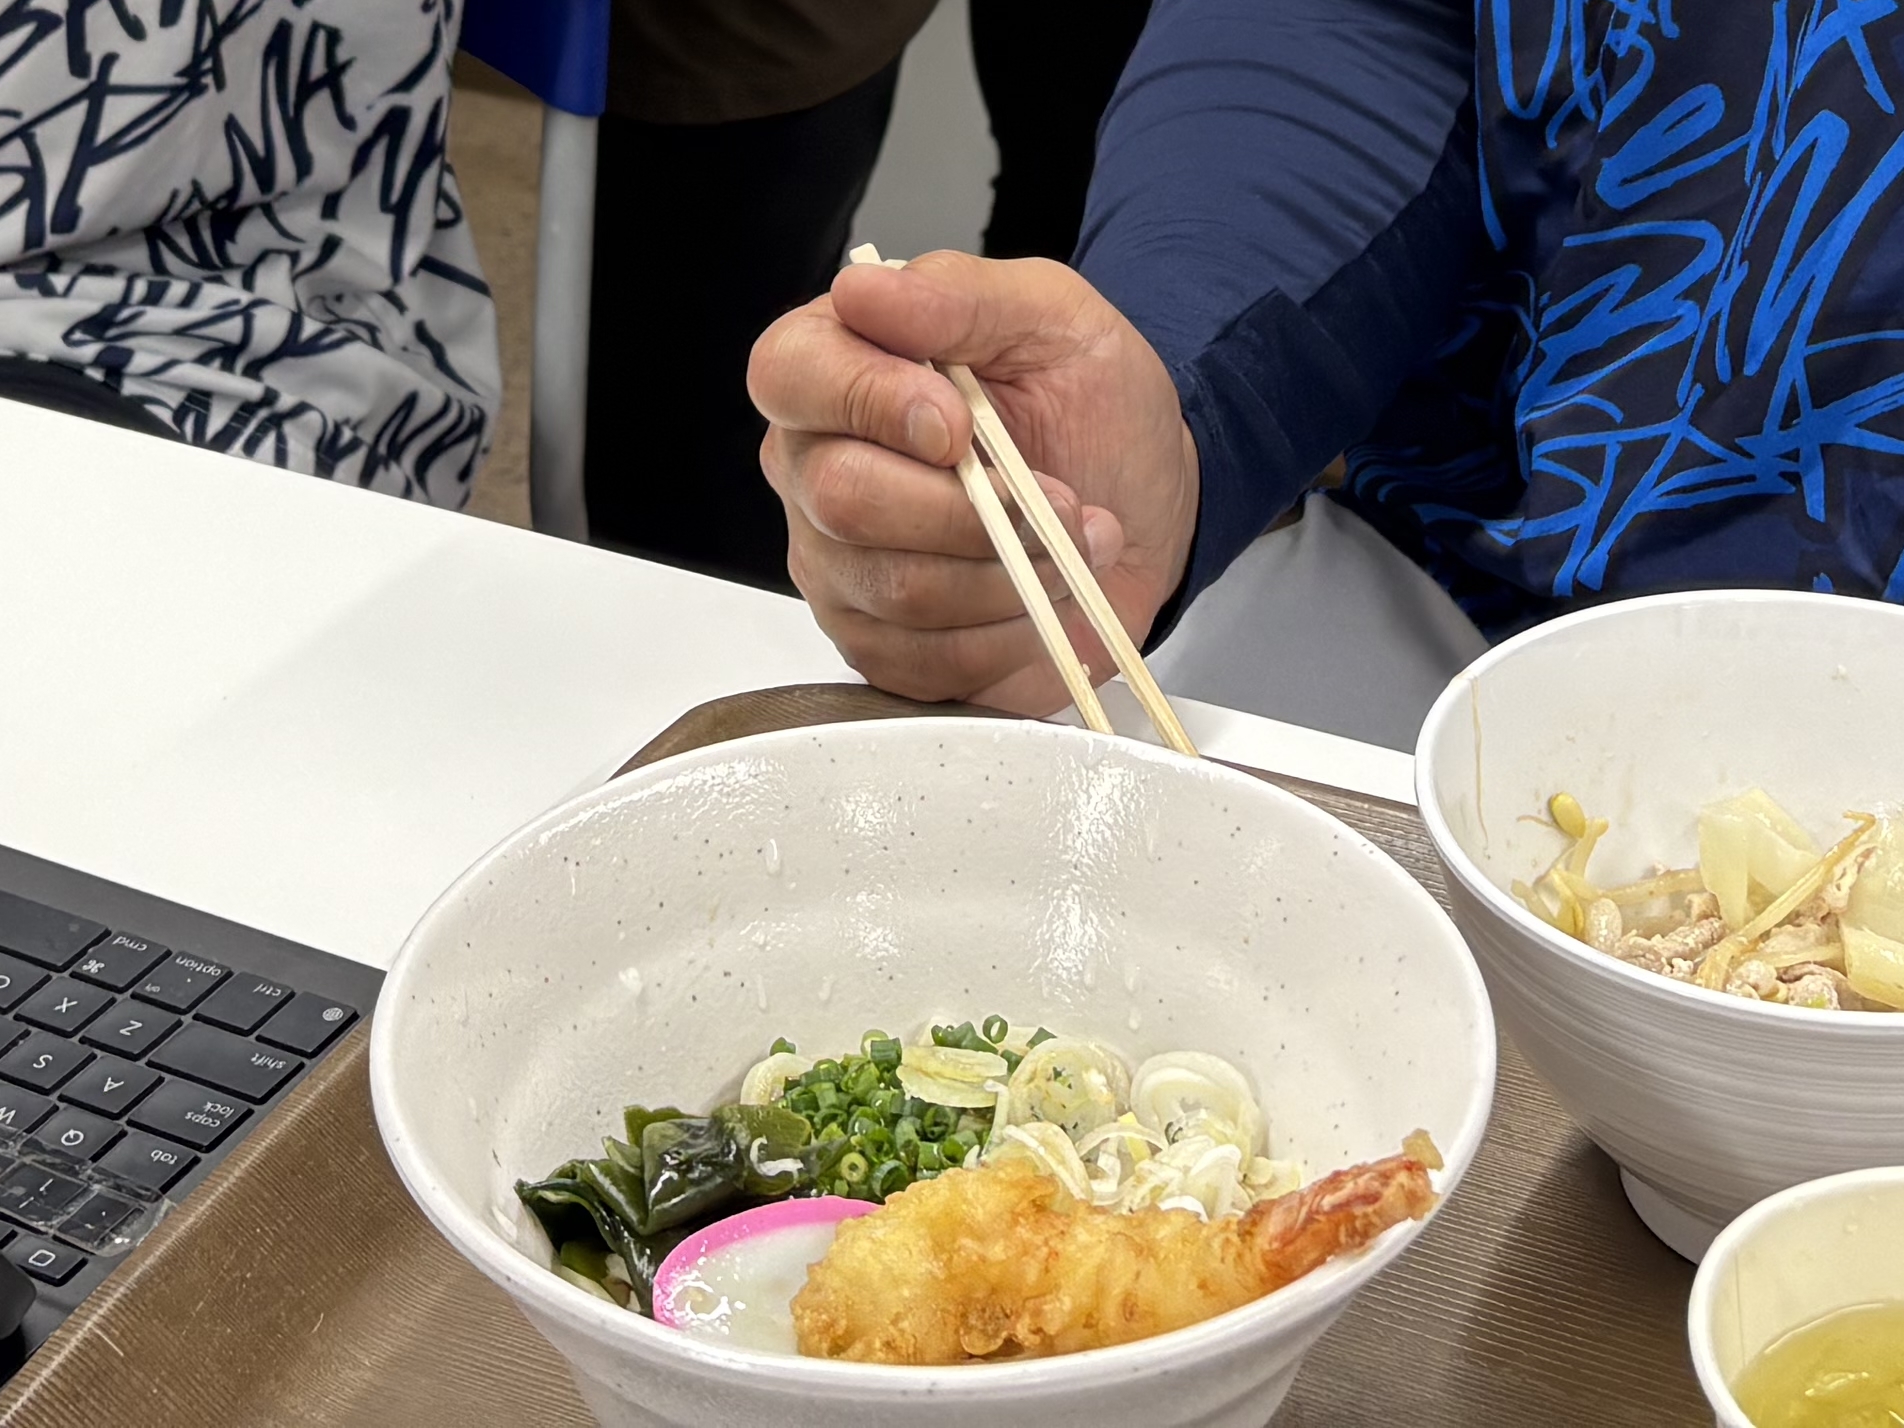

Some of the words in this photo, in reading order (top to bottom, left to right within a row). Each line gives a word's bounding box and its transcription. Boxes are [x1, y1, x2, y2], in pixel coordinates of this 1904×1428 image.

[112, 934, 149, 952] cmd
[174, 955, 223, 978] option
[252, 982, 282, 999] ctrl
[249, 1051, 287, 1071] shift
[183, 1109, 222, 1129] caps
[202, 1100, 236, 1119] lock
[149, 1148, 179, 1166] tab
